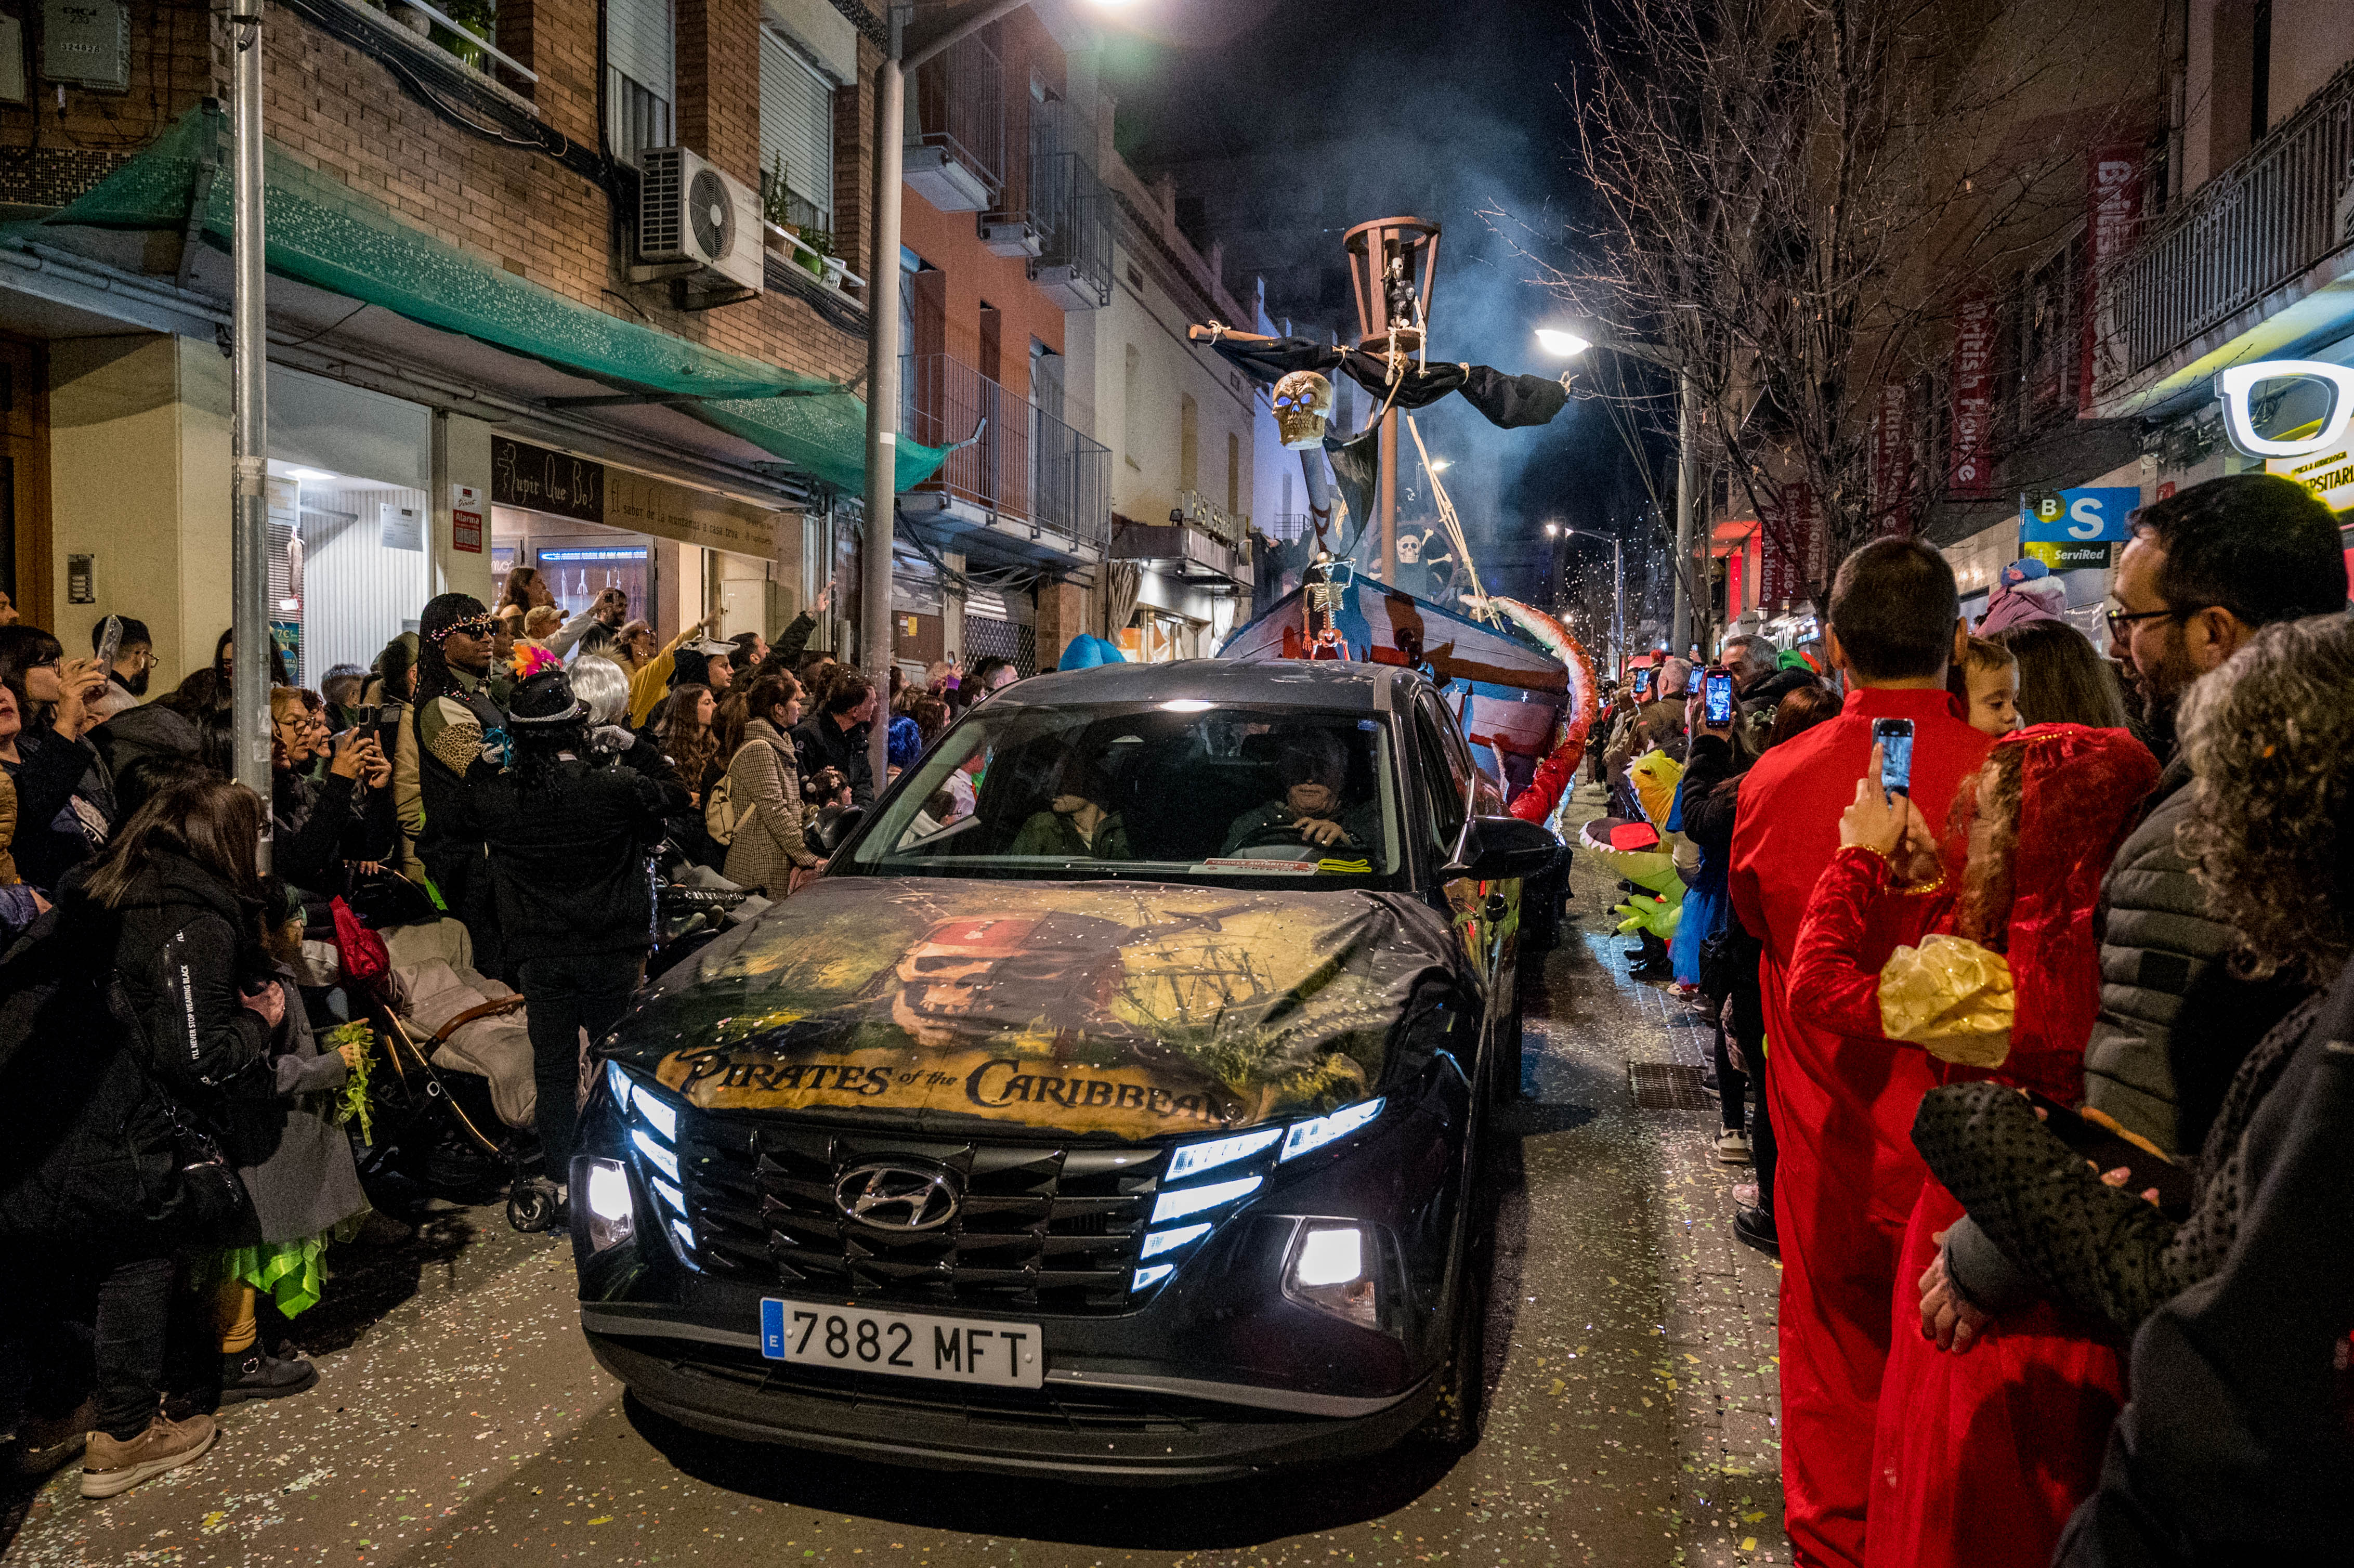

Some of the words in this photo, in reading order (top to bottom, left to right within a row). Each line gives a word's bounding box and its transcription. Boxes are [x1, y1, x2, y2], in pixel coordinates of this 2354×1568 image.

[1957, 398, 1985, 481] Houe
[498, 443, 540, 505] Rupit
[546, 454, 566, 504] Que
[572, 461, 595, 508] Bo!
[456, 512, 479, 525] Alarma
[611, 479, 620, 513] El
[623, 480, 643, 516] sabor
[646, 488, 655, 520] de
[709, 525, 722, 535] casa
[725, 528, 738, 539] teva
[2068, 498, 2104, 540] S
[1783, 543, 1796, 590] Huse
[2054, 549, 2104, 560] ServiRed
[1763, 559, 1776, 602] House
[180, 964, 190, 984] BLACK
[184, 985, 194, 1012] WEARING
[187, 1013, 196, 1028] STOP
[189, 1028, 199, 1048] NEVER
[676, 1049, 893, 1095] PIRATES
[899, 1068, 924, 1086] of
[926, 1069, 959, 1087] the
[965, 1059, 1231, 1123] CARIBBEAN
[769, 1335, 779, 1348] E
[793, 1311, 913, 1367] 7882
[934, 1326, 1027, 1377] MFT
